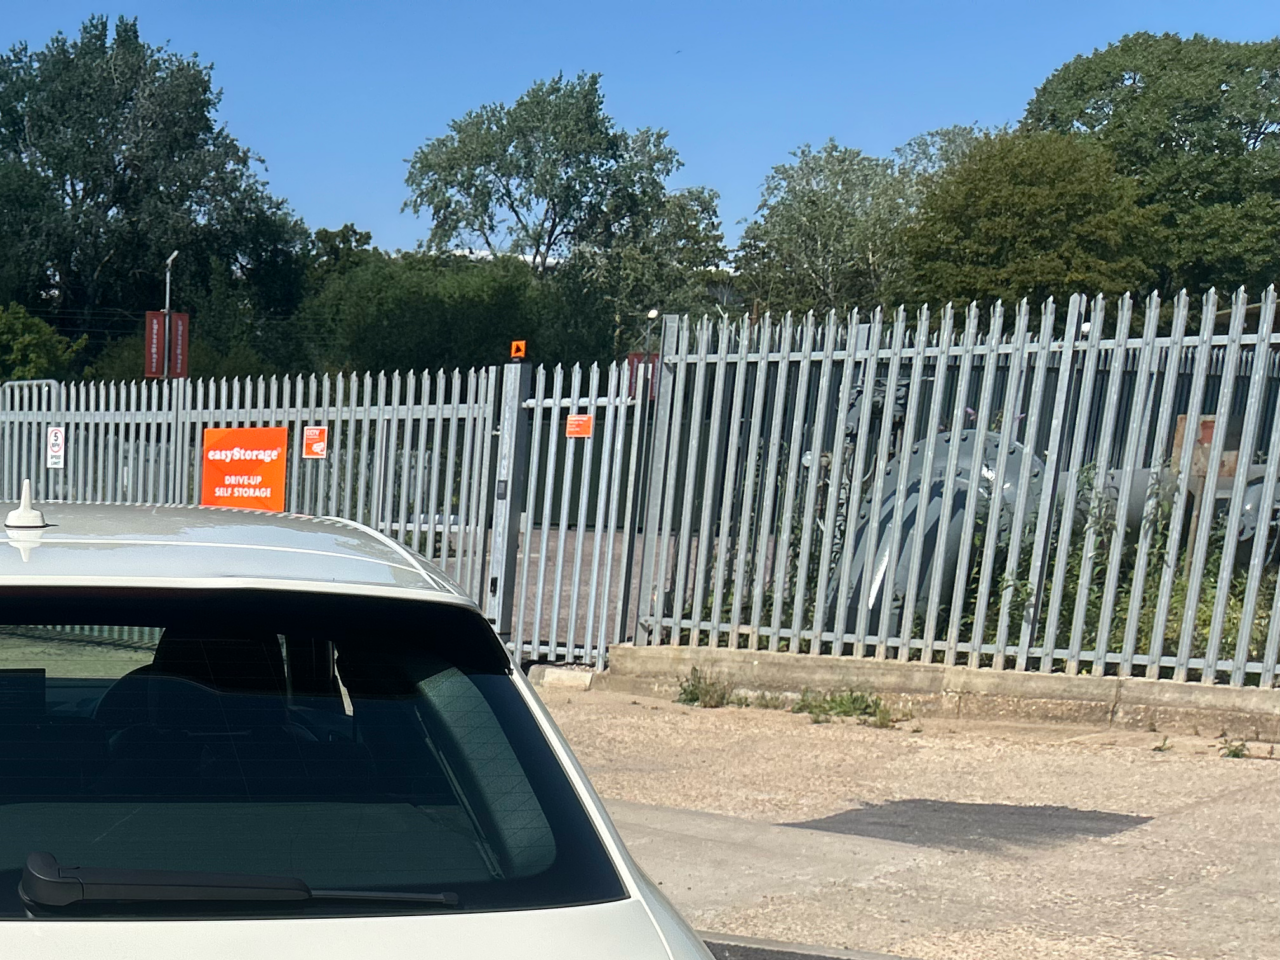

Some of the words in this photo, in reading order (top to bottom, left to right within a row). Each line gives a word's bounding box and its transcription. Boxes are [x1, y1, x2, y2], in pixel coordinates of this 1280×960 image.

[53, 432, 59, 442] 5
[207, 446, 279, 463] easyStorage
[224, 475, 262, 485] DRIVE-UP
[214, 486, 232, 497] SELF
[233, 486, 272, 498] STORAGE
